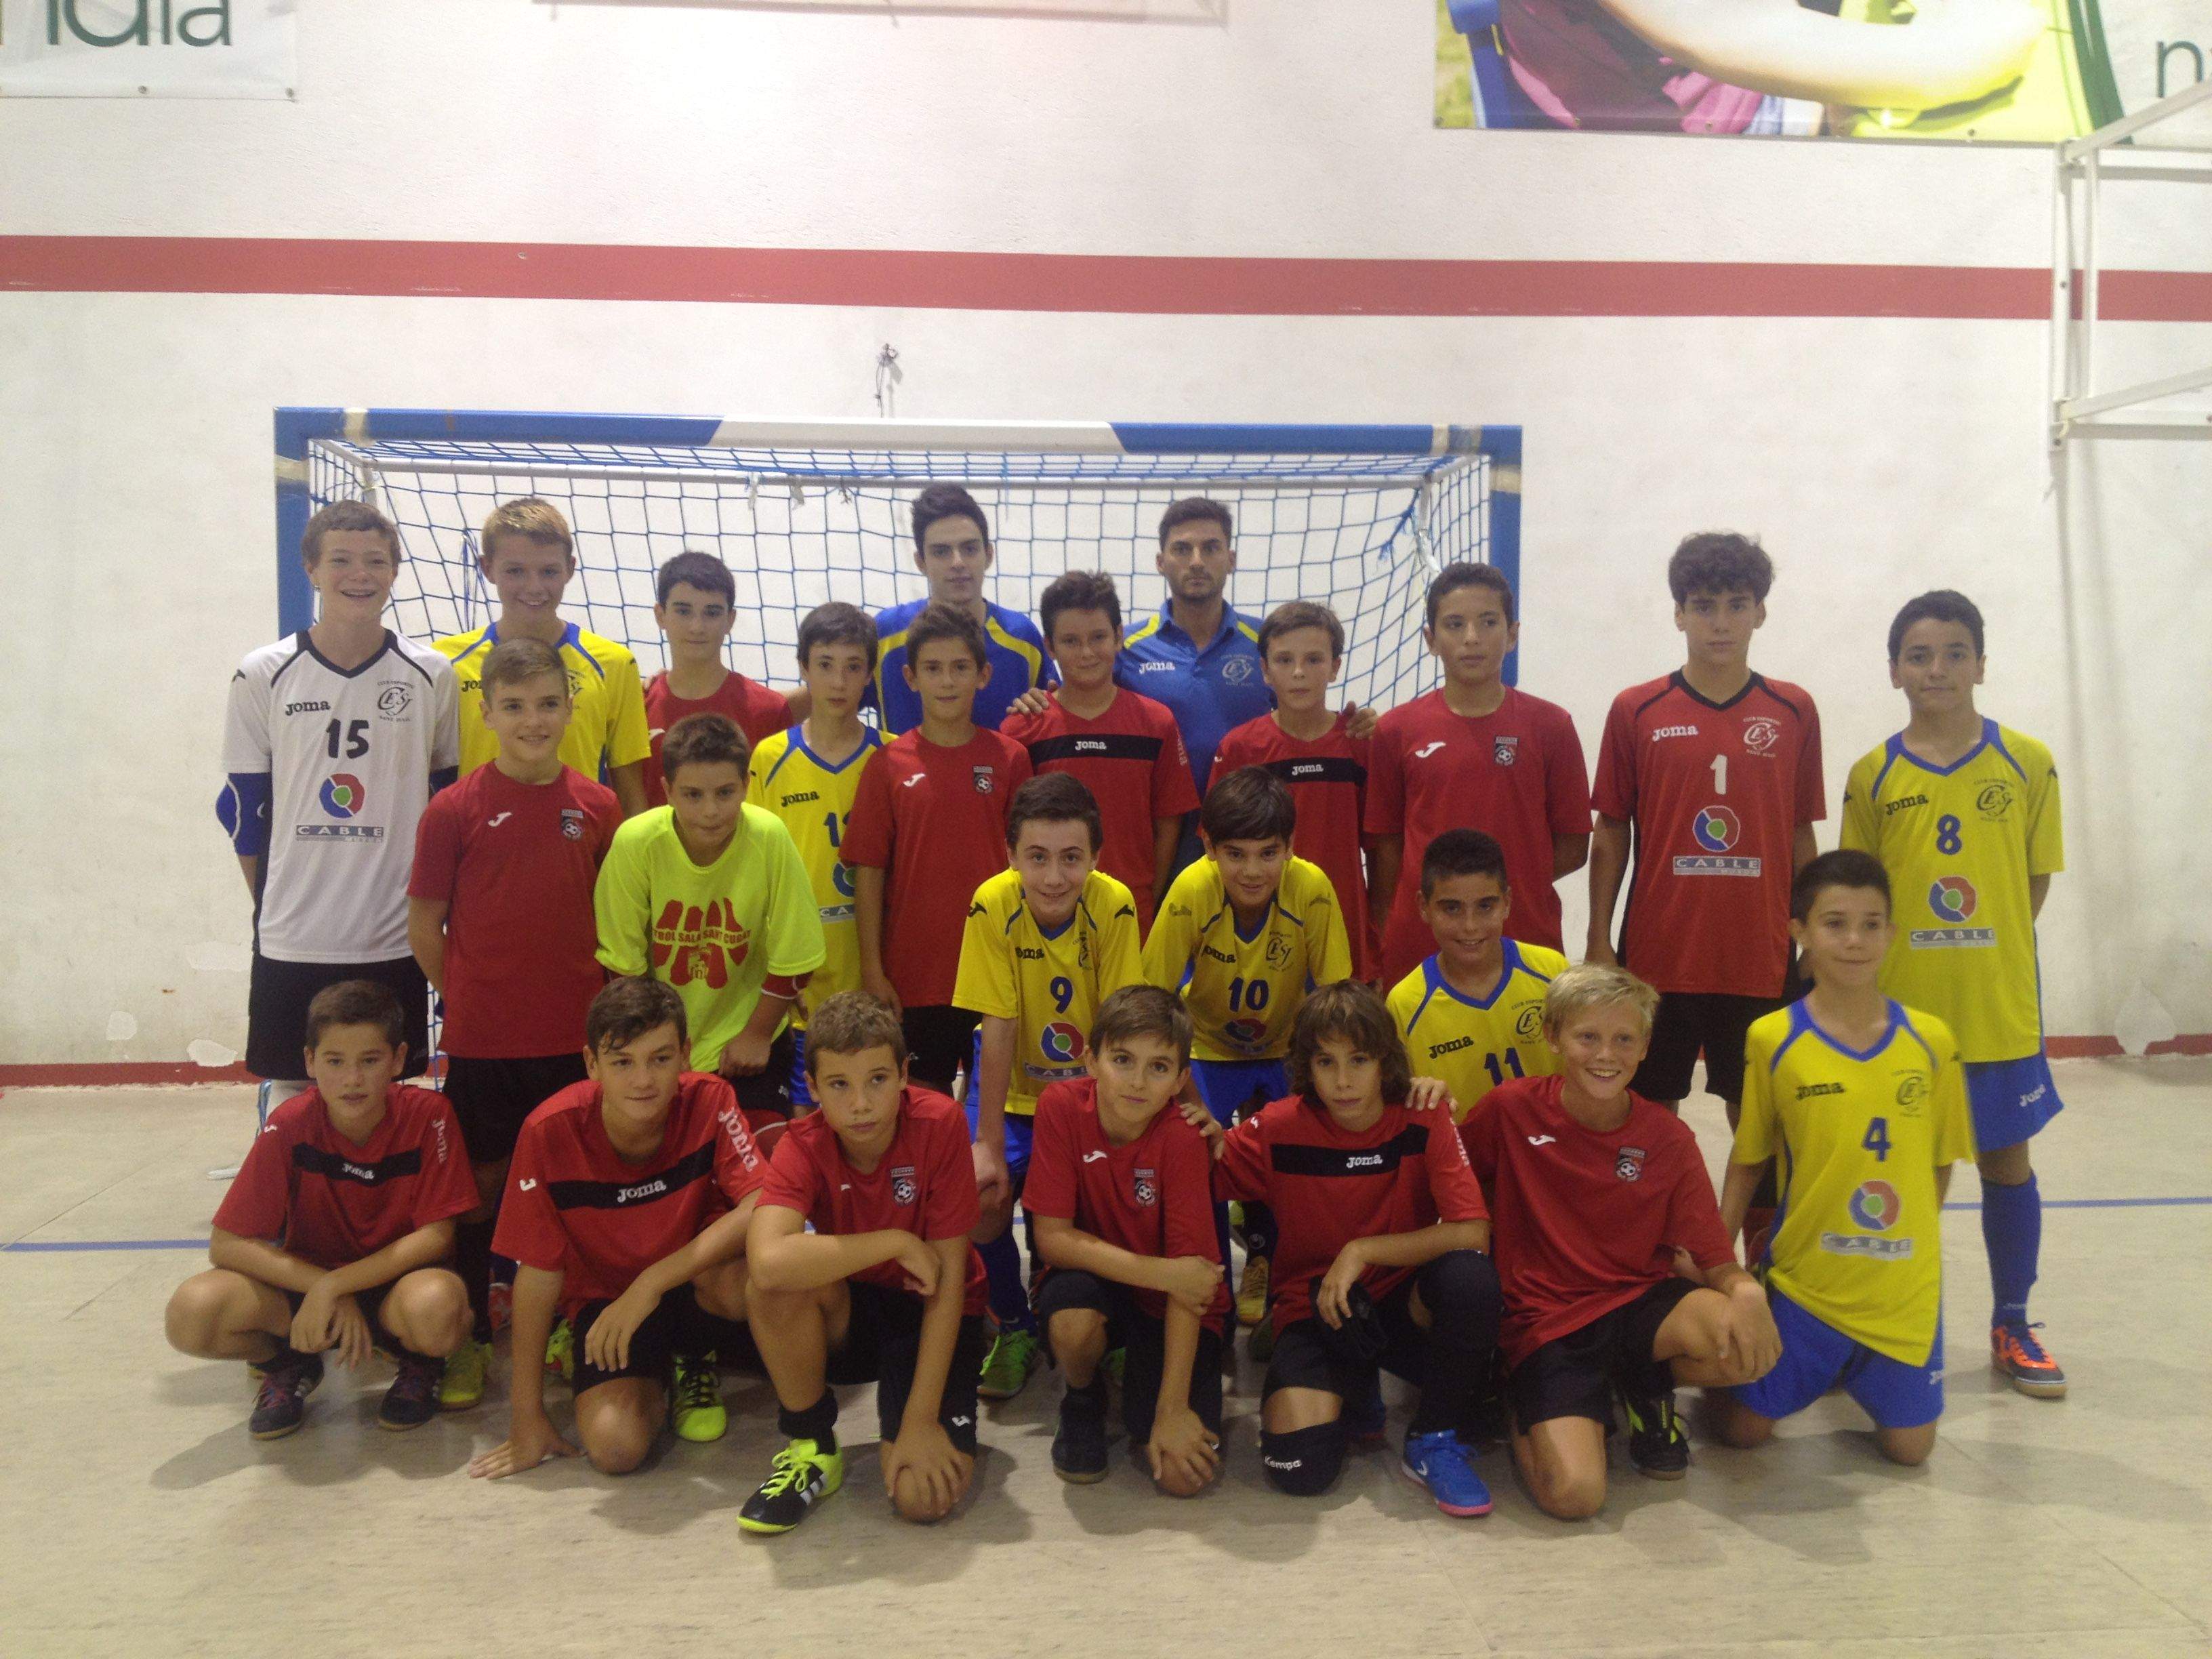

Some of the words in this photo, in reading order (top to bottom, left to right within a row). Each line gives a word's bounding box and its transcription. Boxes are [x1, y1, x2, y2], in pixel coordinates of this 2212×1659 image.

[285, 701, 331, 716] Joma
[326, 718, 369, 759] 15
[1652, 725, 1698, 742] Joma
[1075, 741, 1107, 751] Joma
[1292, 764, 1324, 776] Joma
[1710, 754, 1728, 795] 1
[781, 791, 820, 808] Joma
[1886, 794, 1929, 816] Joma
[297, 826, 383, 837] CABLE
[824, 812, 850, 847] 1
[1936, 815, 1963, 855] 8
[1676, 859, 1759, 869] CABLE
[1912, 930, 1994, 941] CABLE
[1050, 976, 1073, 1014] 9
[1228, 977, 1269, 1012] 10
[1429, 1036, 1475, 1059] Joma
[1026, 1065, 1087, 1078] CAB
[1484, 1047, 1525, 1086] 11
[718, 1106, 758, 1172] Joma
[1862, 1117, 1891, 1163] 4
[1346, 1154, 1384, 1169] Joma
[617, 1179, 667, 1204] Joma
[1265, 1454, 1303, 1471] Kempa
